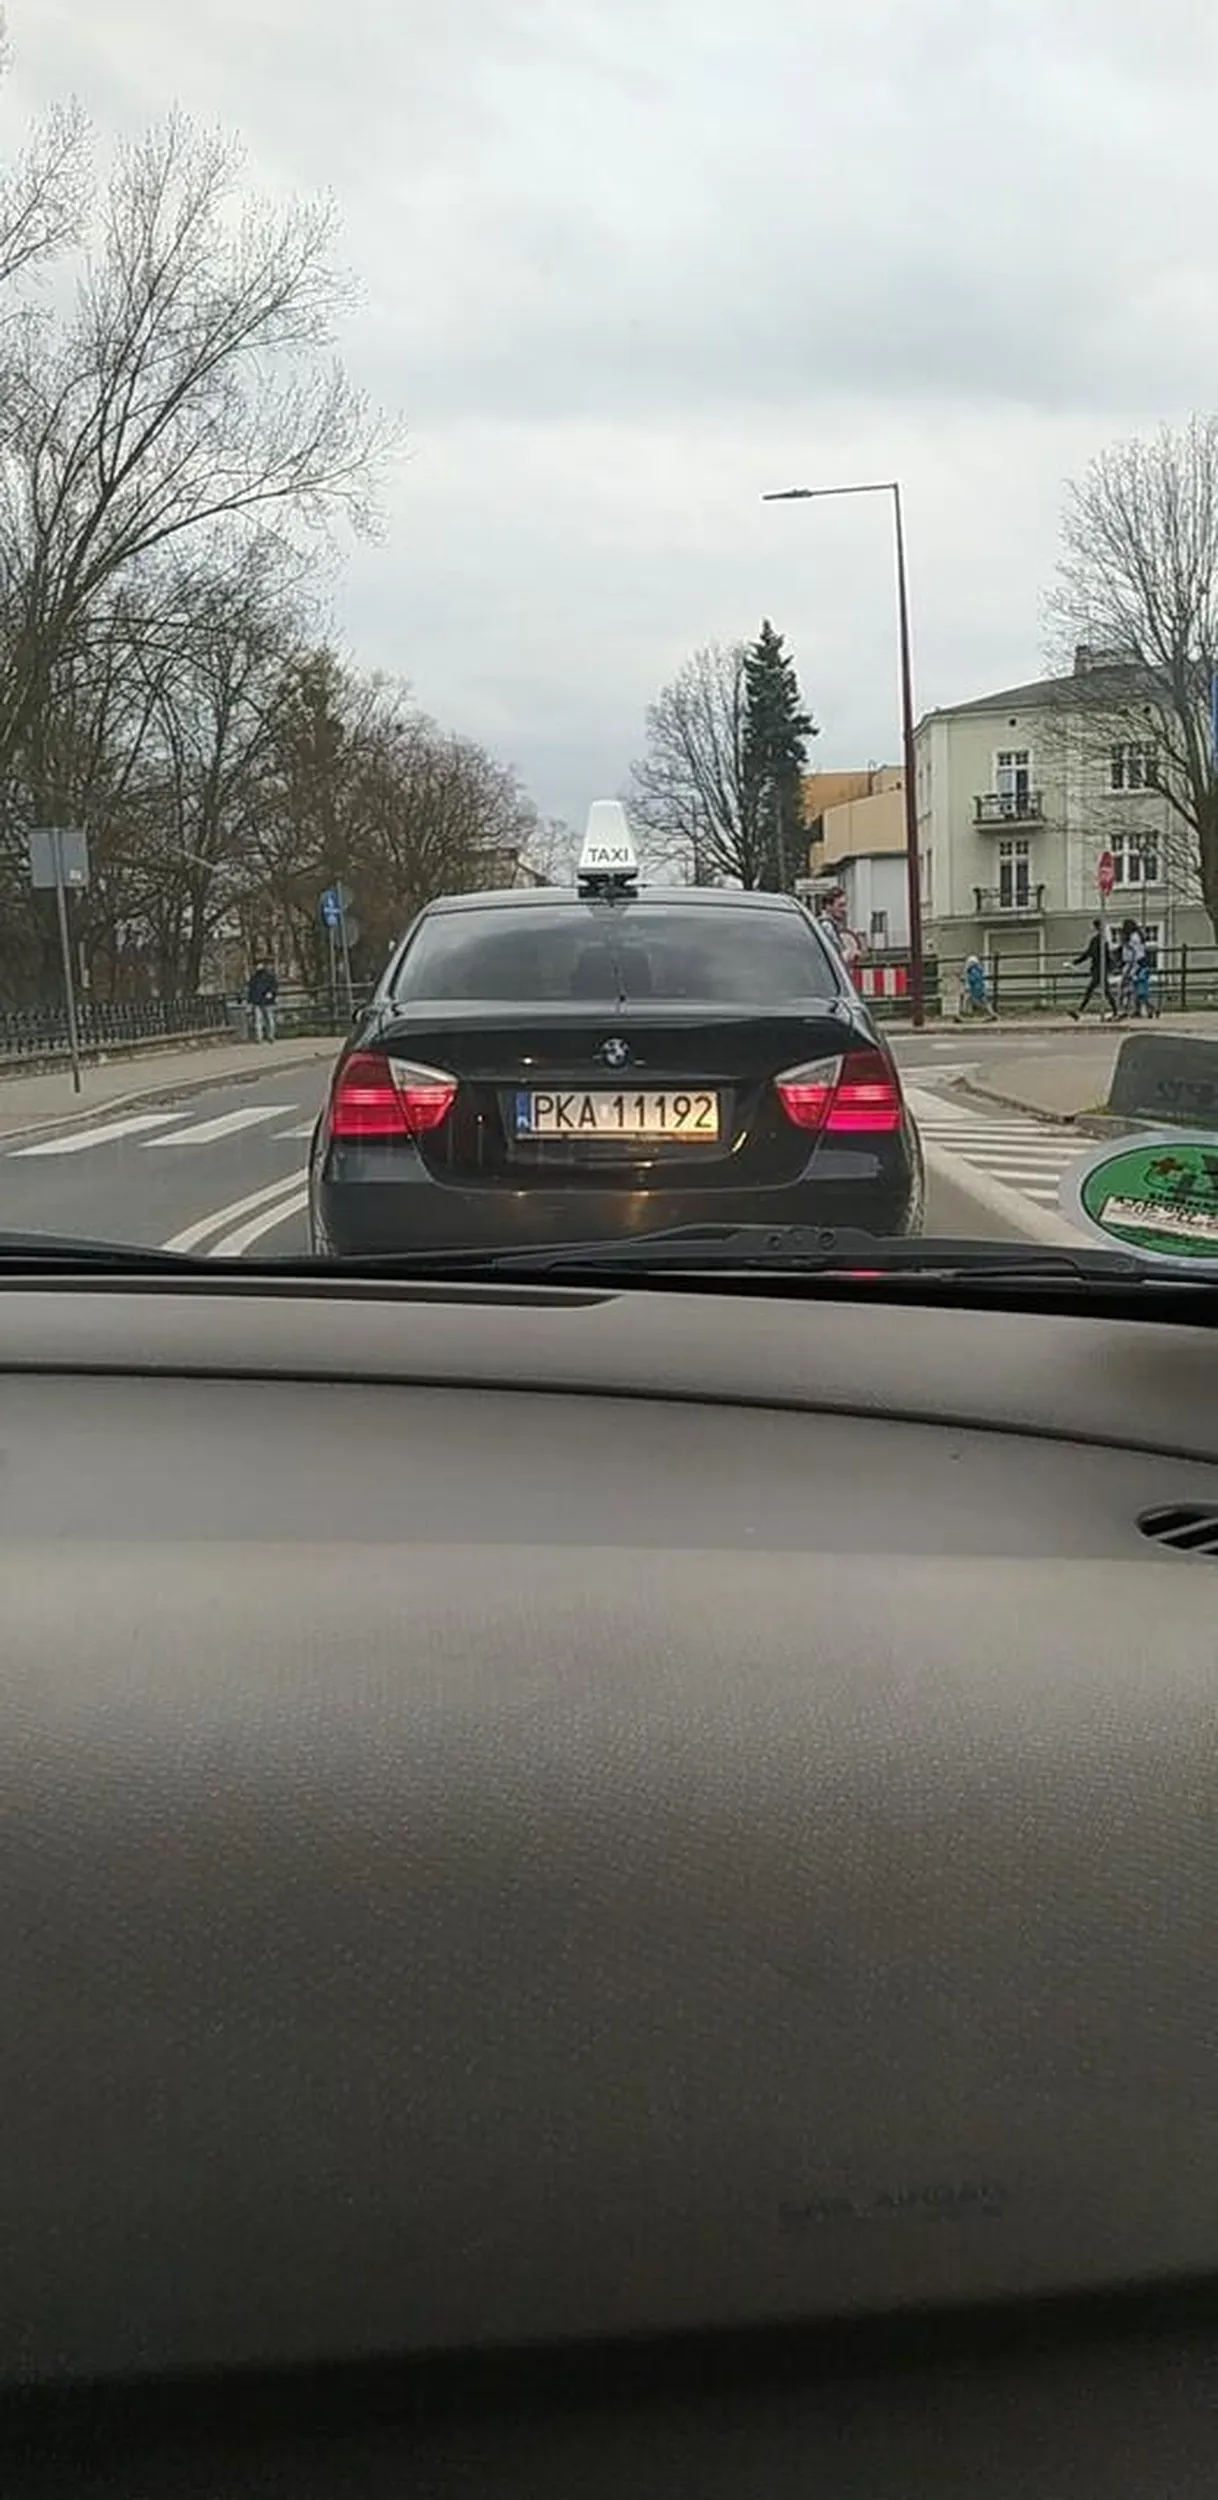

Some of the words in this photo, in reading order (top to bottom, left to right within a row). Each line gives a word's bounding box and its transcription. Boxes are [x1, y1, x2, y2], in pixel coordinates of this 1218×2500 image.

[588, 847, 629, 862] TAXI
[534, 1095, 597, 1128] PKA
[613, 1095, 713, 1128] 11192
